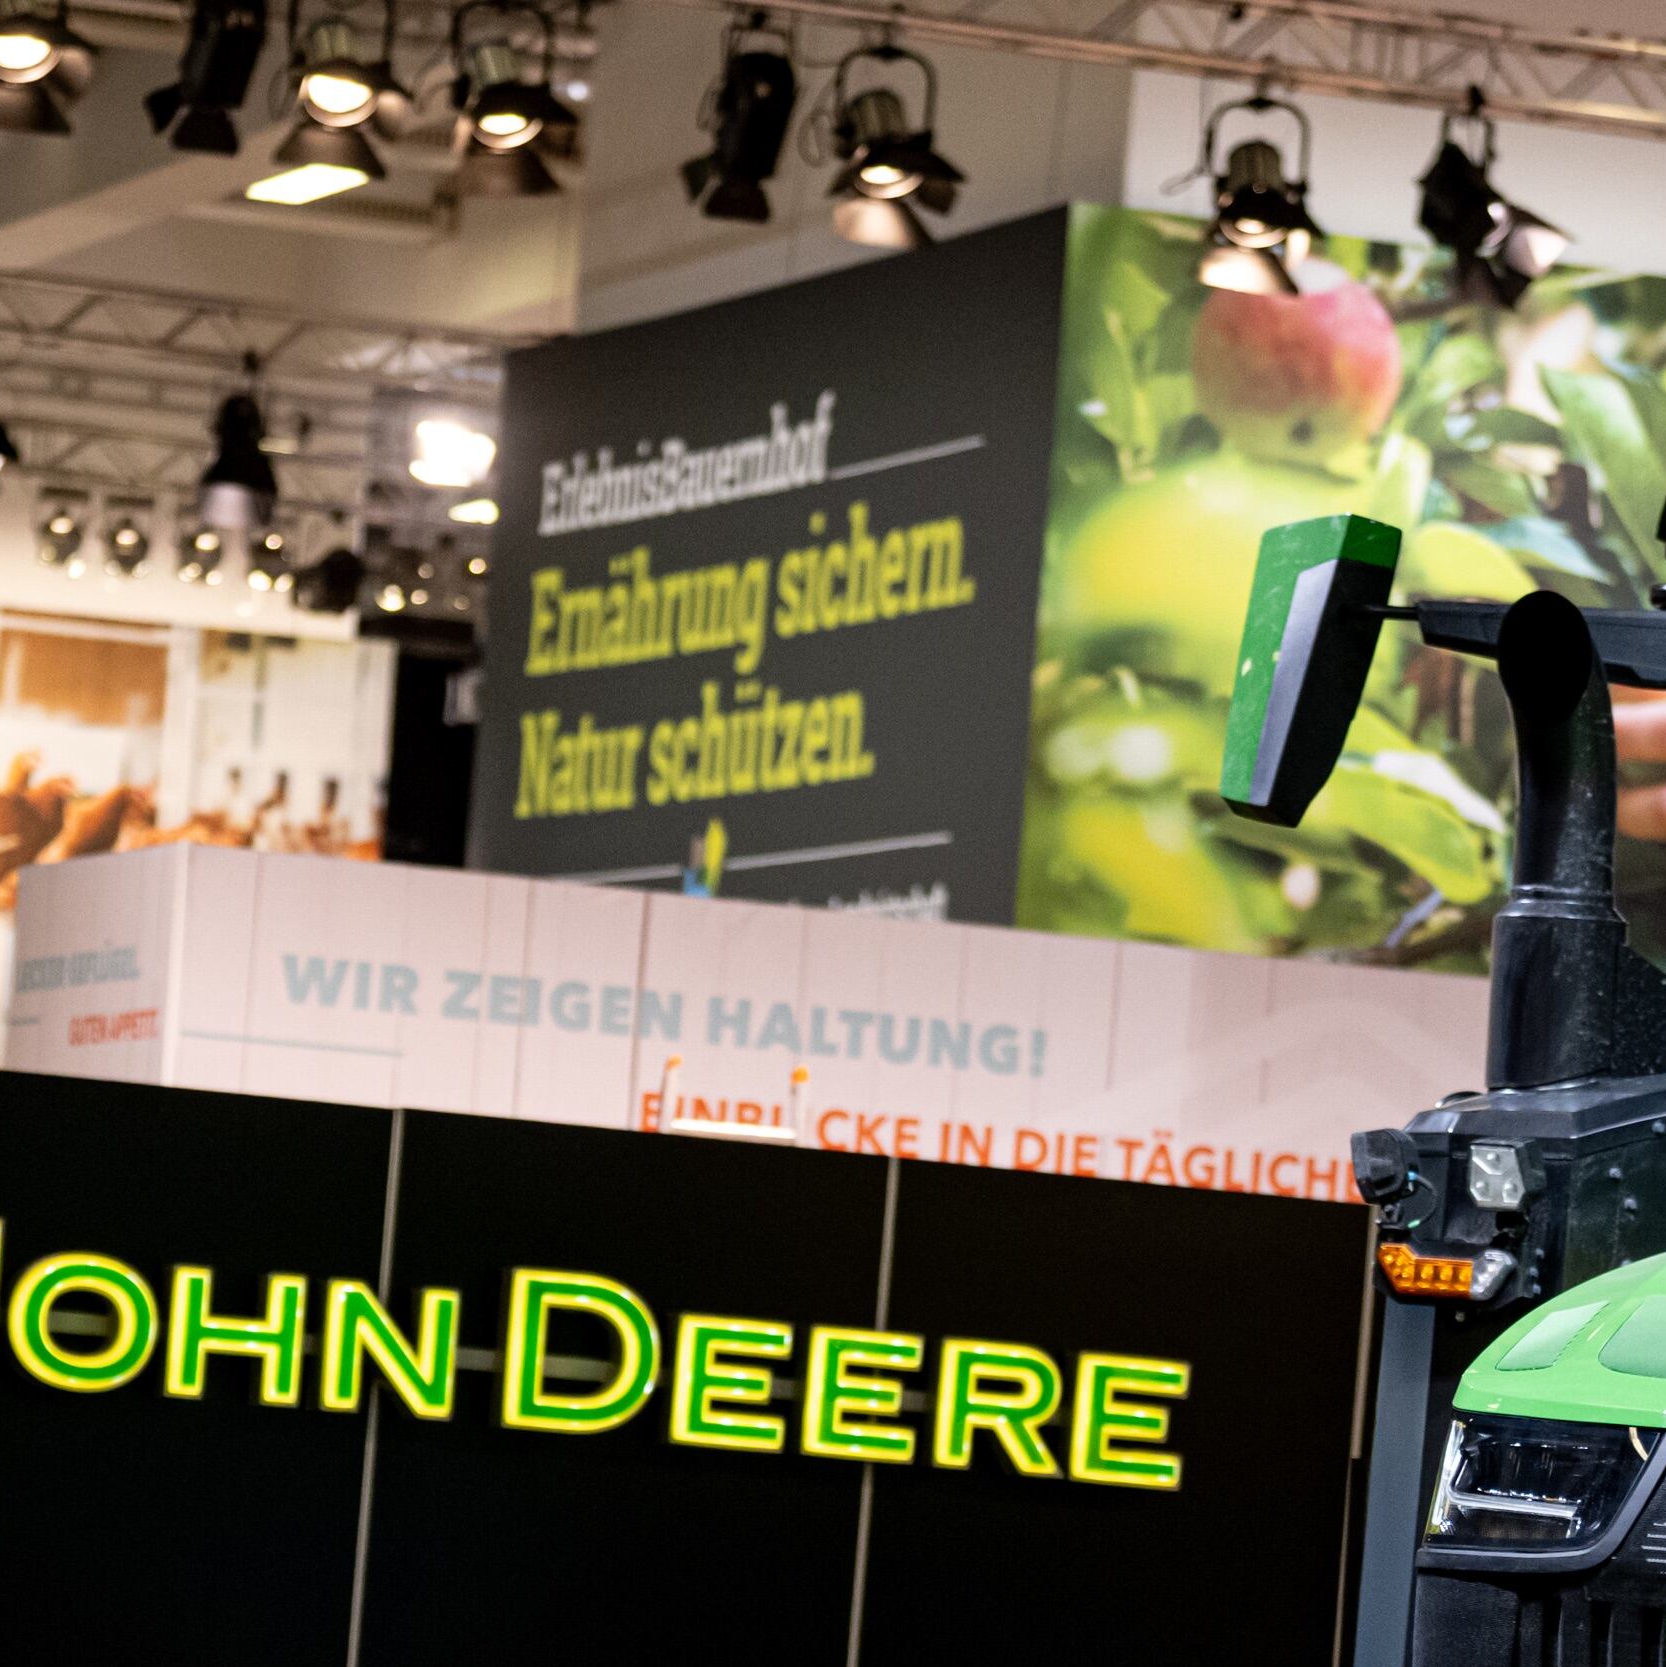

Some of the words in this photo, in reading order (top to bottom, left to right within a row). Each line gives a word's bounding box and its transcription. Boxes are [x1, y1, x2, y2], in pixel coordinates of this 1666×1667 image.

[538, 391, 835, 537] ErlebnisBauernhof
[524, 545, 770, 676] Ernährung
[774, 501, 976, 638] sichern.
[514, 711, 644, 818] Natur
[647, 680, 876, 806] schützen.
[281, 953, 419, 1016] WIR
[441, 968, 682, 1043] ZEIGEN
[705, 995, 1049, 1078] HALTUNG!
[939, 1121, 993, 1168] IN
[1012, 1128, 1098, 1180] DIE
[500, 1266, 1192, 1491] DEERE
